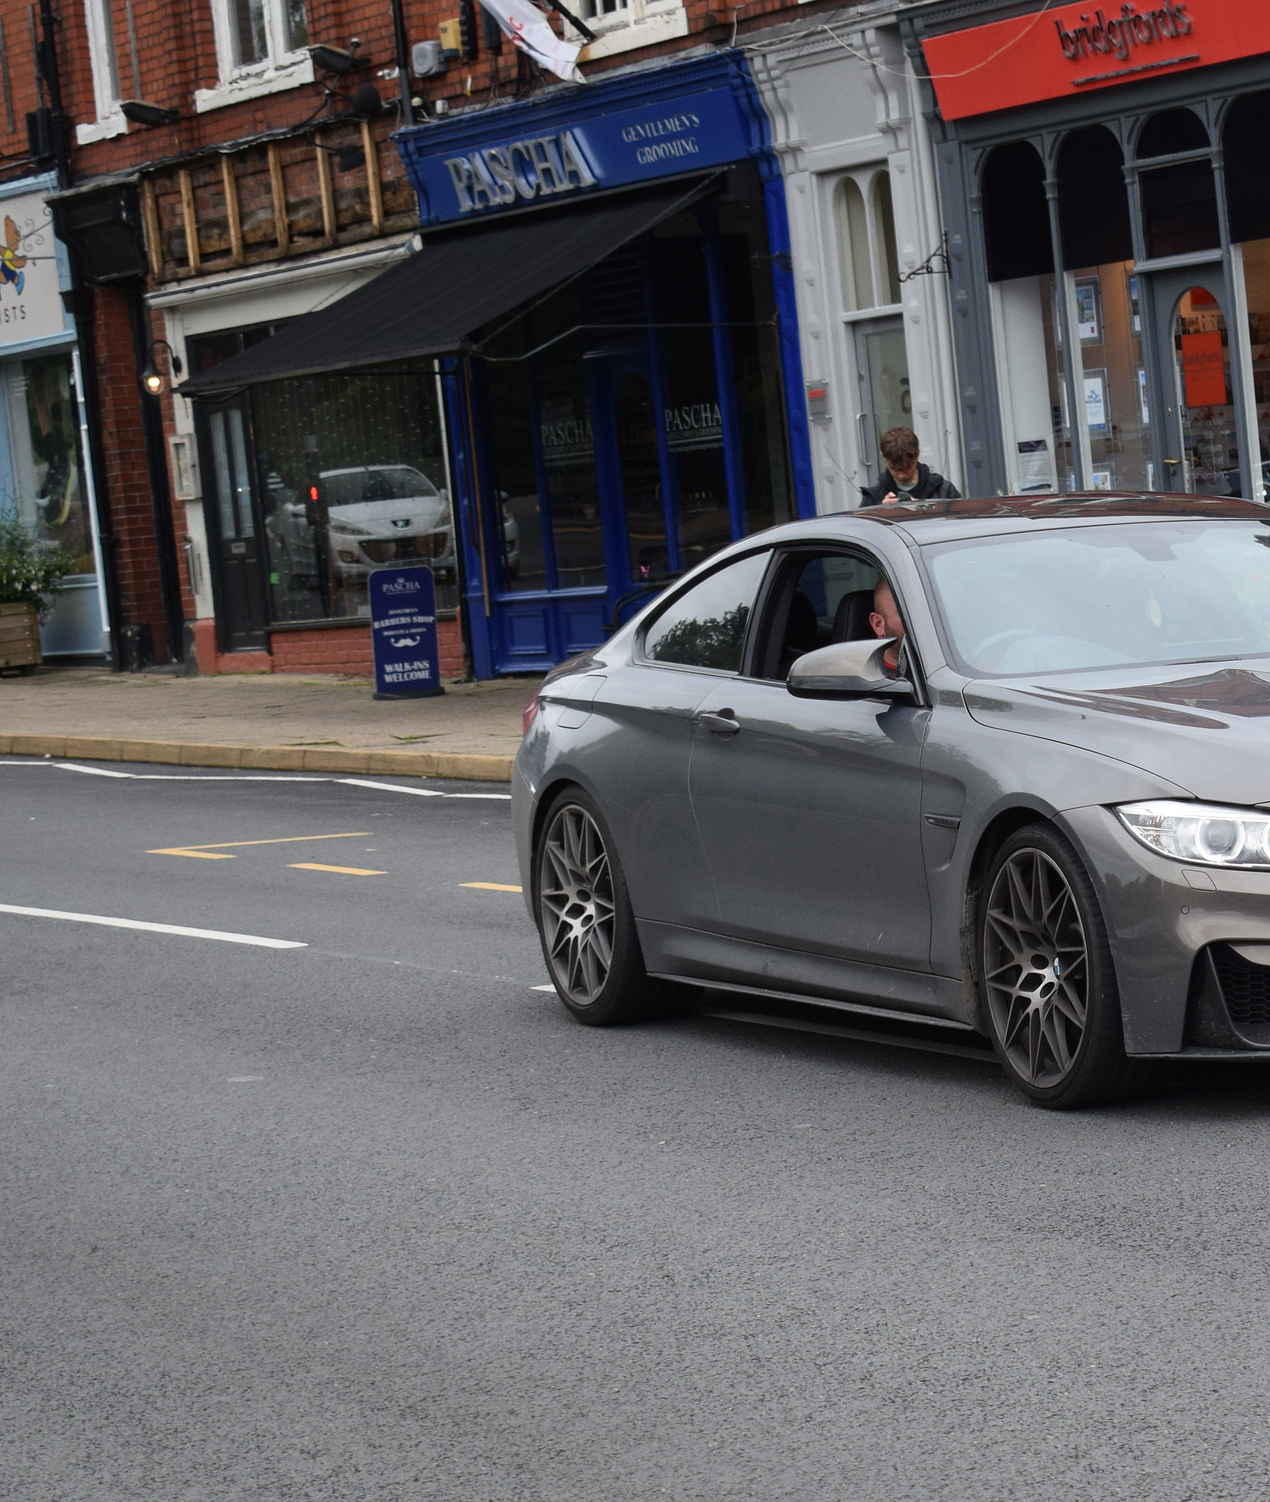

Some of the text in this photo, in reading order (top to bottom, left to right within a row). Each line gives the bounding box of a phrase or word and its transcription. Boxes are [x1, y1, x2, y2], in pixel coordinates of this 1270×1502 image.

[1054, 0, 1194, 60] bridgfords
[622, 114, 700, 143] GENTLEMEN'S
[636, 138, 700, 165] GROOMING
[444, 129, 598, 213] PASCHA
[1184, 351, 1221, 366] bridgfords
[664, 403, 723, 431] PASCHA
[541, 420, 594, 447] PASCHA
[382, 581, 421, 593] PASCHA
[413, 615, 435, 624] SHOP
[384, 660, 430, 673] WALK-INS
[384, 670, 431, 683] WELCOME
